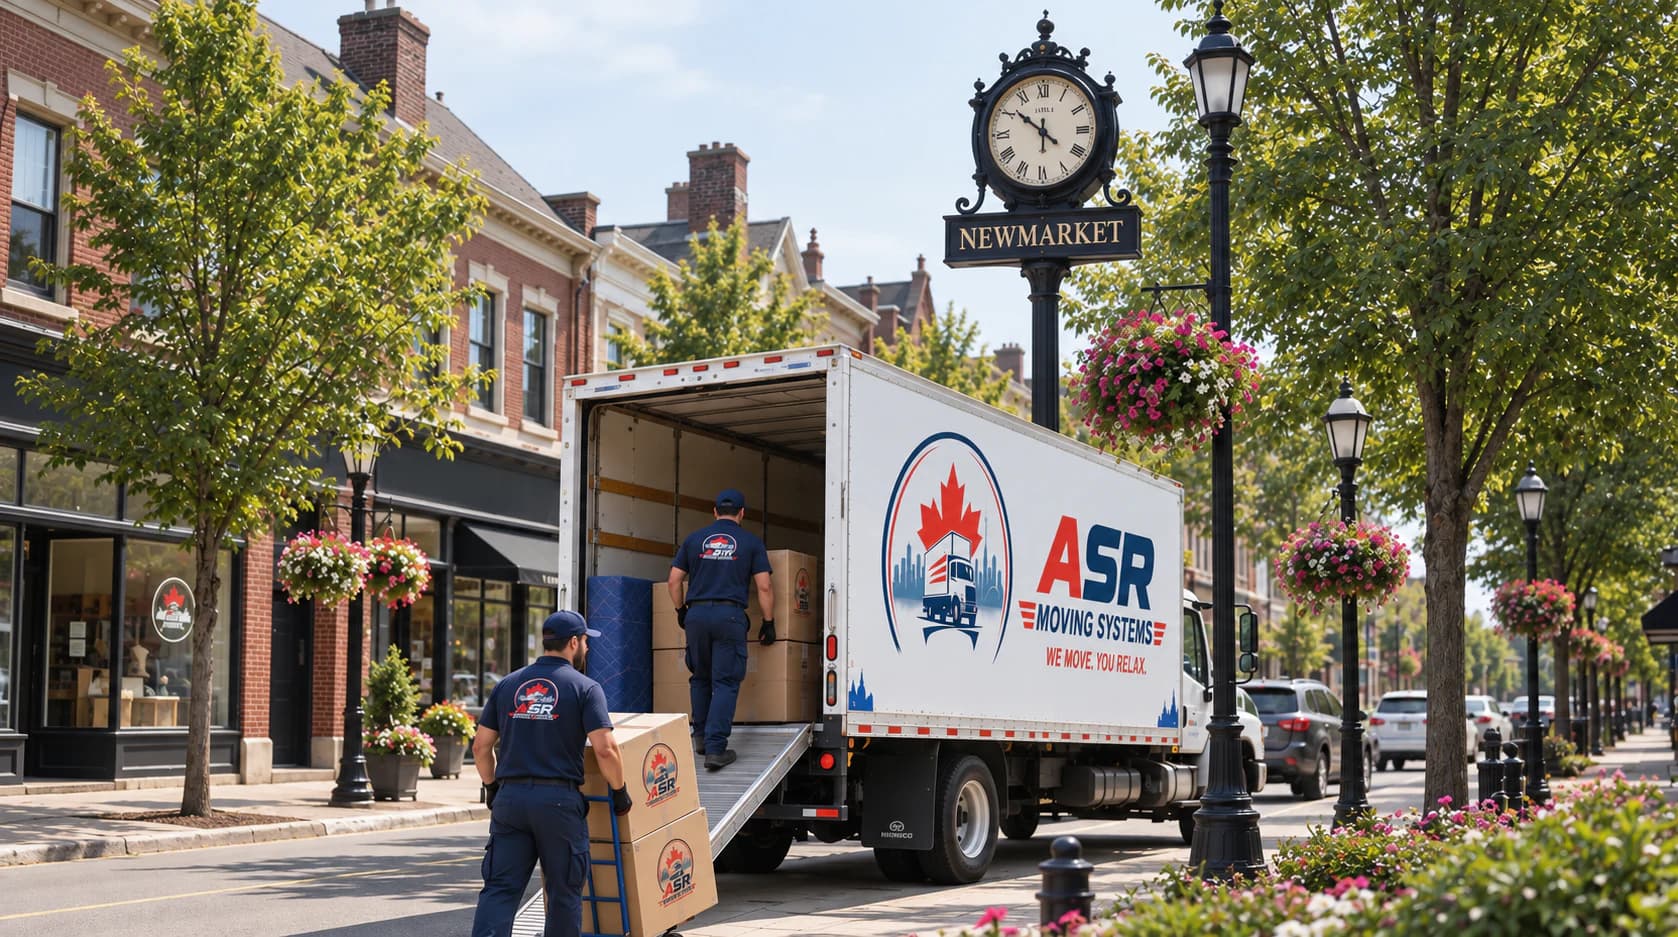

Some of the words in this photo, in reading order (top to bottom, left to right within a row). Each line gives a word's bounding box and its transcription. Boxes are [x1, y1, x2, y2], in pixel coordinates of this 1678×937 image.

[959, 220, 1124, 250] NEWMARKET
[1036, 515, 1155, 610] ASR
[1036, 604, 1093, 638] MOVING
[1096, 613, 1153, 645] SYSTEMS
[1046, 647, 1062, 667] WE
[1064, 649, 1093, 670] MOVE.
[1096, 652, 1115, 672] YOU
[1116, 654, 1147, 675] RELAX.
[515, 703, 554, 715] ASR
[647, 777, 675, 801] ASR
[662, 873, 691, 899] ASR
